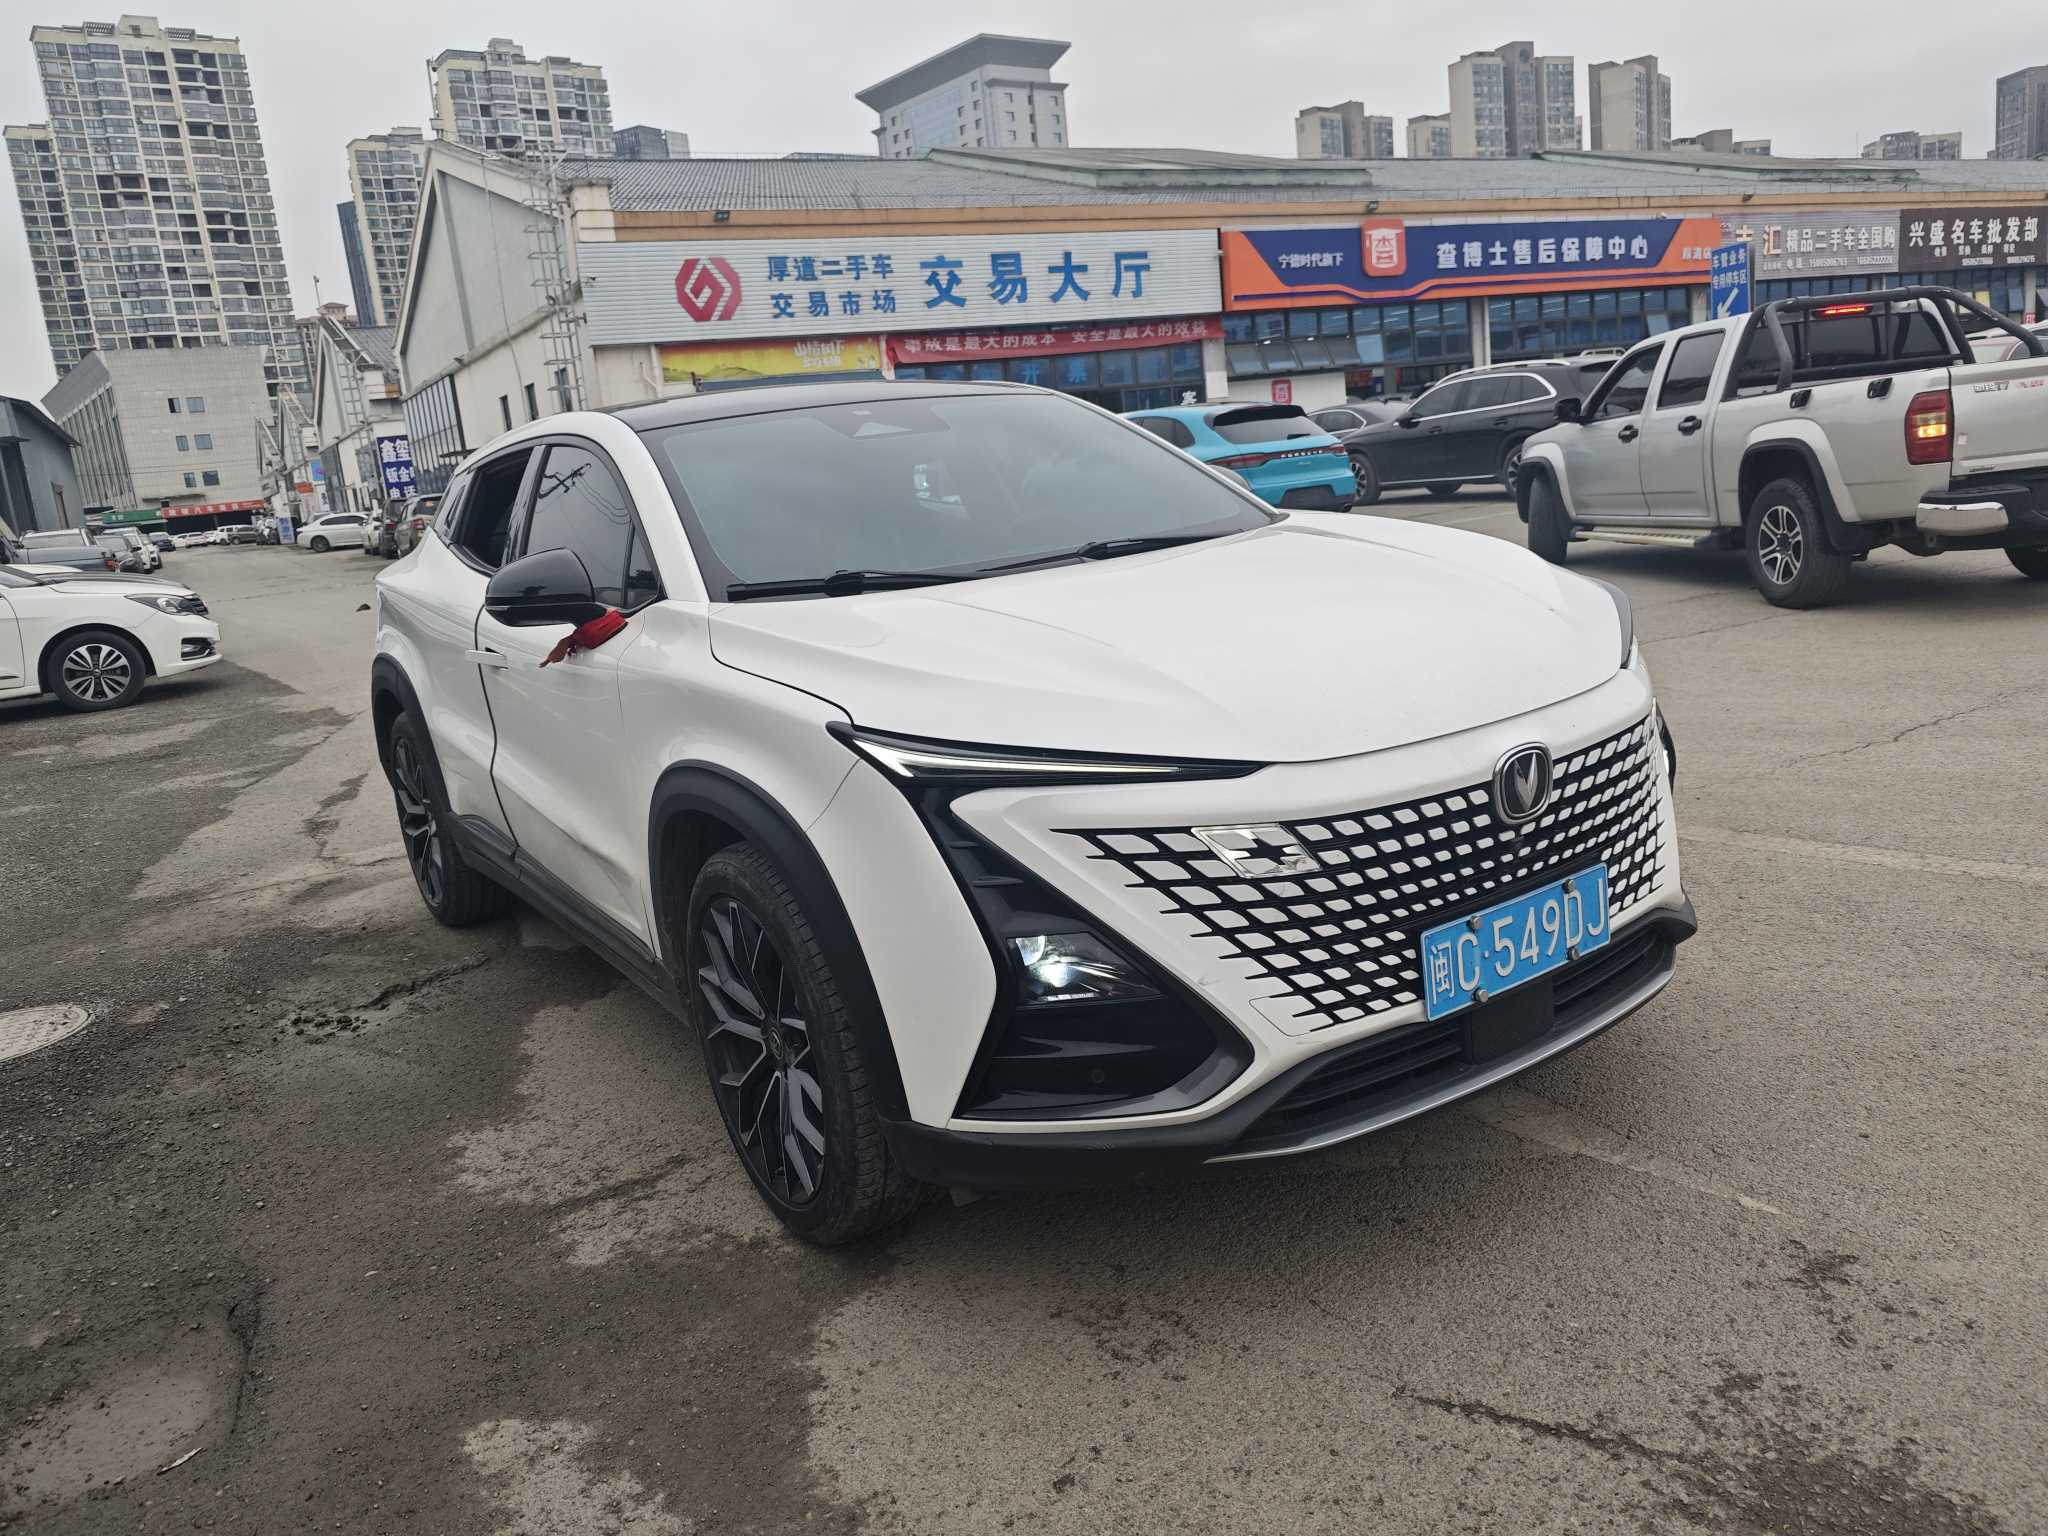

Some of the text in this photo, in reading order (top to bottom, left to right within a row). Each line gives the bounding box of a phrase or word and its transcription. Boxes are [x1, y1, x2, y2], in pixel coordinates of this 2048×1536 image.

[1909, 217, 2038, 247] 兴盛名车批发部
[1436, 234, 1648, 269] 查博士售后保障中心
[767, 254, 895, 282] 厚道二手车
[919, 251, 1150, 308] 交易大厅
[770, 290, 896, 318] 交易市场
[904, 334, 1056, 353] 事故是最大的成本
